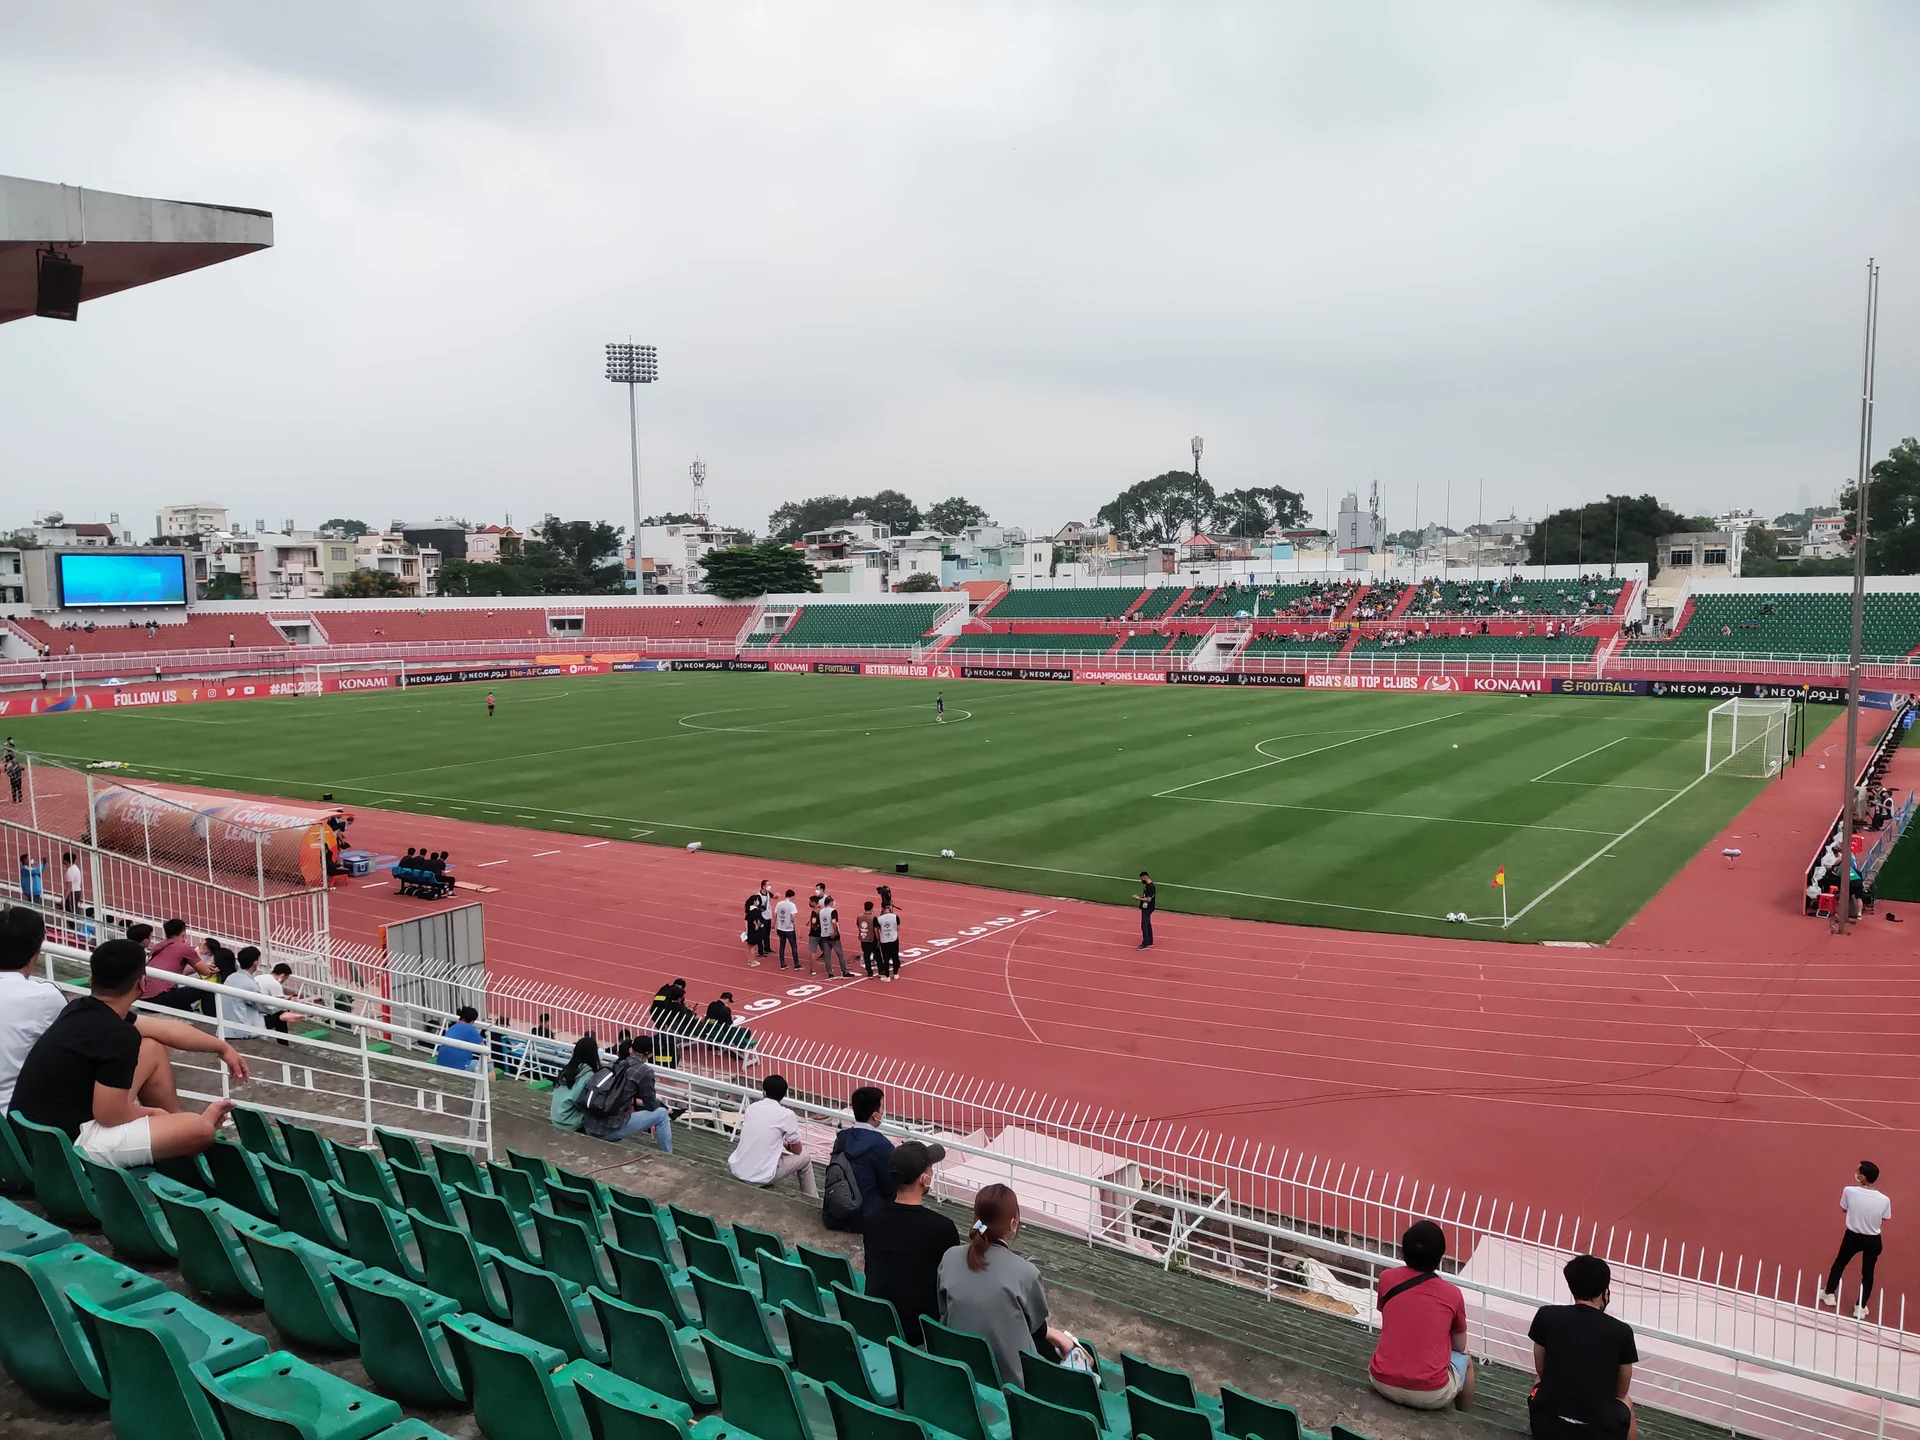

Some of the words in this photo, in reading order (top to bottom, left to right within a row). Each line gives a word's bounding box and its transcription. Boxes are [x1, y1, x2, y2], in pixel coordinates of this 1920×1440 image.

[510, 667, 560, 677] the-AFC.com
[774, 663, 808, 672] KONAMI
[865, 665, 889, 675] BETTER
[890, 665, 909, 675] THAN
[910, 666, 928, 676] EVER
[468, 671, 489, 679] NEOM
[973, 669, 1013, 677] NEOM.COM
[1085, 671, 1132, 681] CHAMPIONS
[1133, 672, 1165, 681] LEAGUE
[1181, 674, 1206, 682] NEOM
[338, 677, 388, 690] KONAMI
[410, 675, 433, 684] NEOM
[1250, 676, 1301, 684] NEOM.COM
[1307, 675, 1342, 687] ASIA'S
[1343, 676, 1358, 688] 40
[1360, 676, 1381, 688] TOP
[1383, 676, 1418, 689] CLUBS
[1474, 678, 1541, 691] KONAMI
[1670, 684, 1707, 694] NEOM
[1771, 688, 1805, 698] NEOM
[114, 691, 160, 707] FOLLOW
[162, 690, 177, 703] US
[233, 809, 317, 831] CHAMPIONS
[983, 917, 1016, 926] 2
[957, 926, 988, 936] 3
[926, 937, 959, 947] 4
[786, 984, 823, 997] 8
